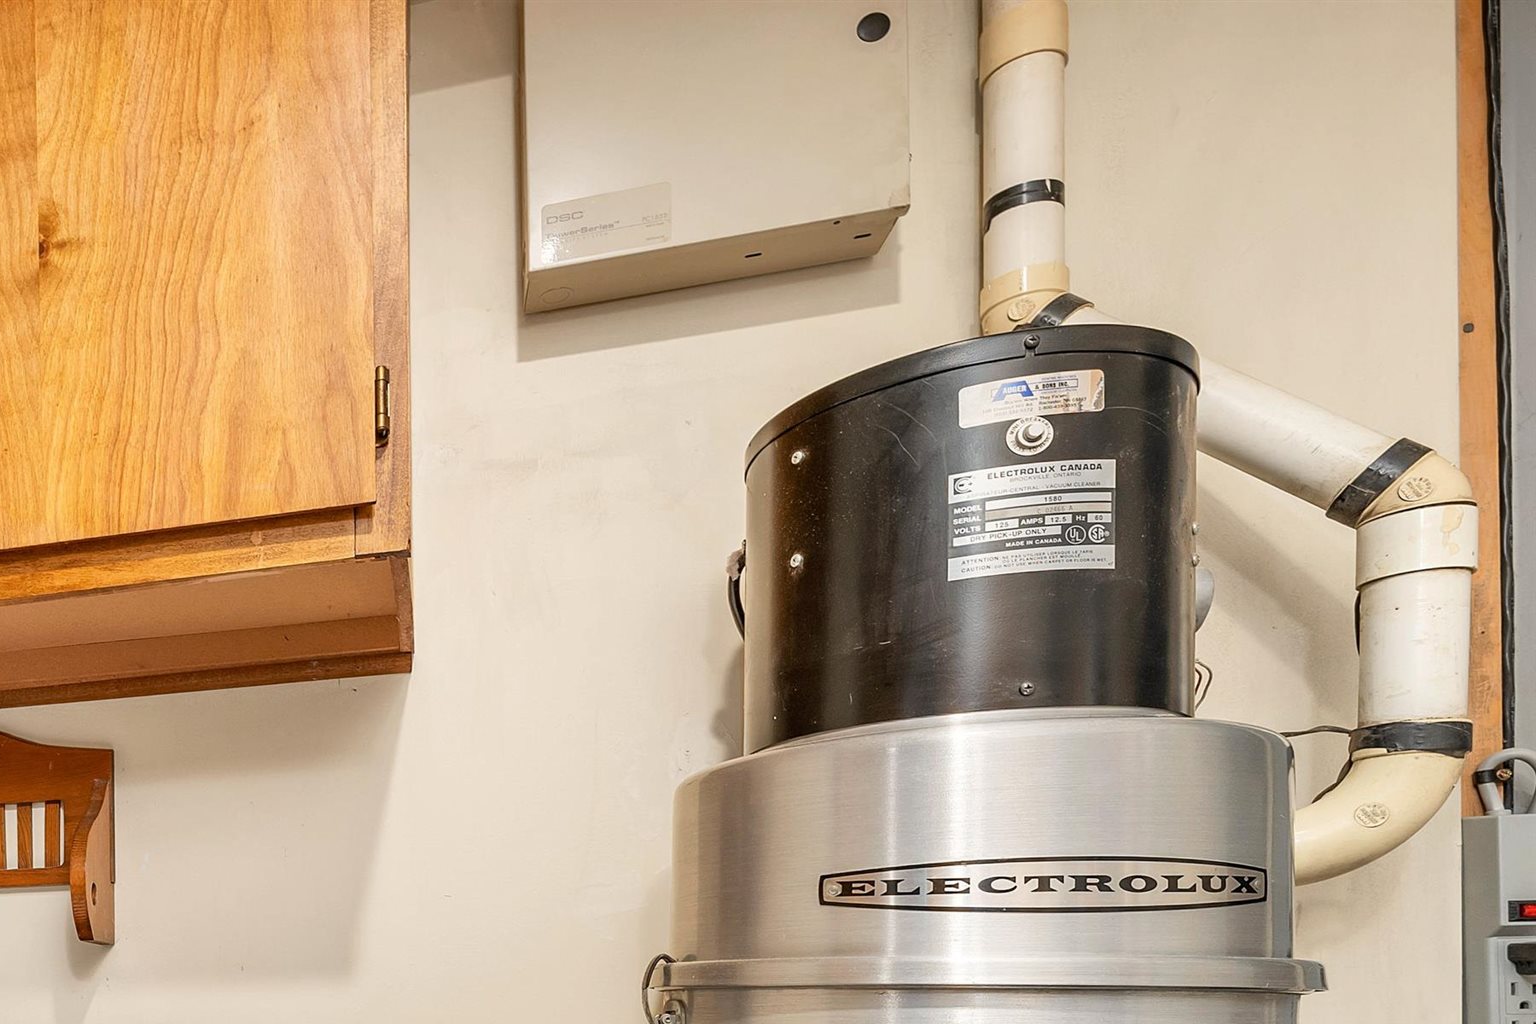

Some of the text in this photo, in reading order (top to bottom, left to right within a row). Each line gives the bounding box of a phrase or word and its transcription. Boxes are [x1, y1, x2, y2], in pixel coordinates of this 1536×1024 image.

[546, 211, 584, 224] DSC
[987, 463, 1103, 480] ELECTROLUX CANADA
[953, 504, 983, 514] MODEL
[953, 515, 982, 526] SERIAL
[954, 525, 982, 535] VOLTS
[1020, 517, 1044, 526] AMPS
[836, 873, 1260, 898] ELECTROLUX
